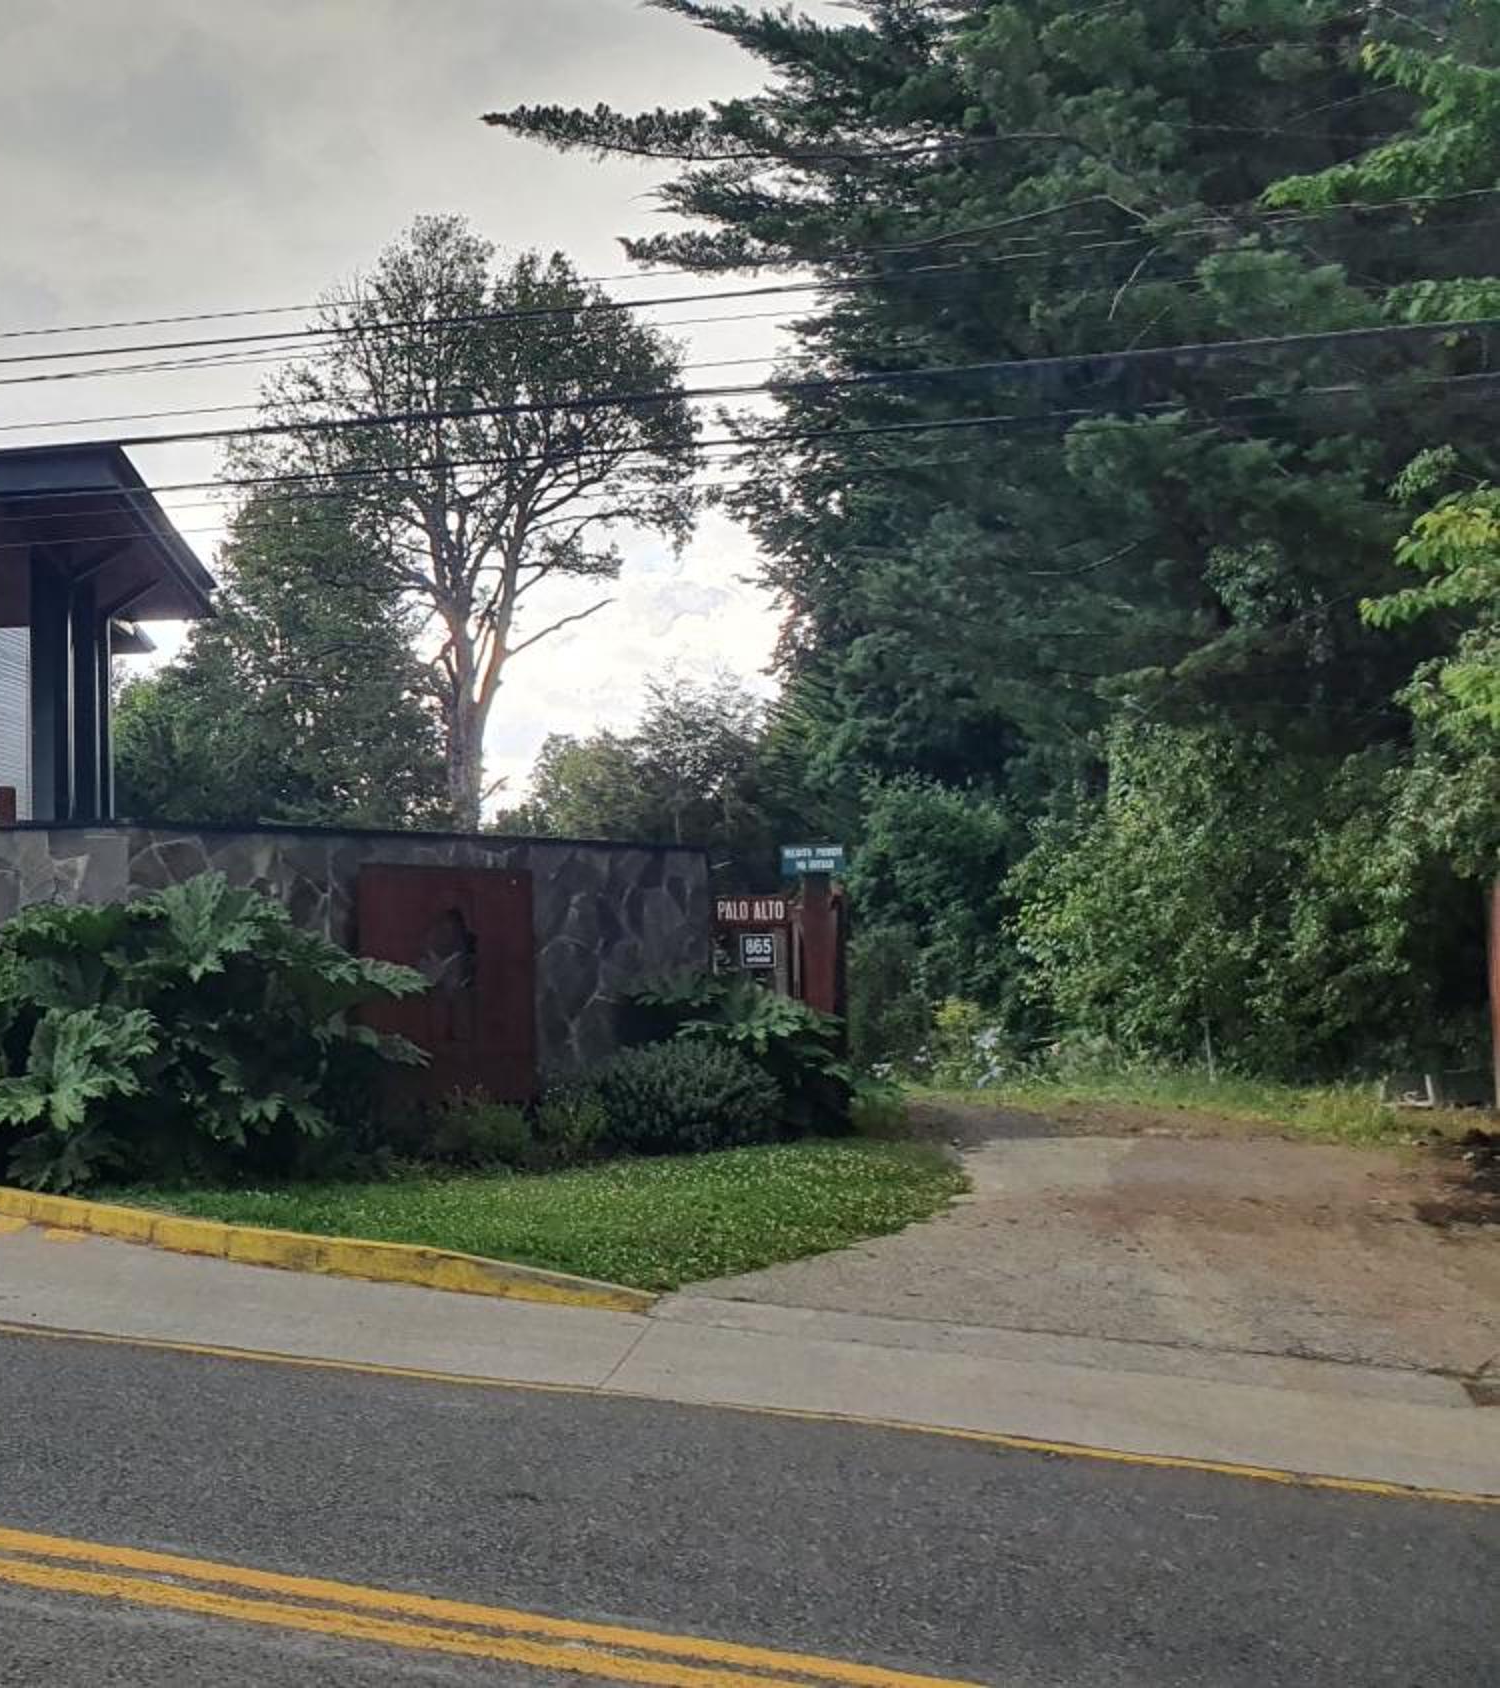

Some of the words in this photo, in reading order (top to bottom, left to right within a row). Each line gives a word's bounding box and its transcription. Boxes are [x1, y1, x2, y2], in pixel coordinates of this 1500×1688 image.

[717, 901, 749, 920] PALO
[753, 901, 785, 920] ALTO
[745, 938, 772, 954] 865
